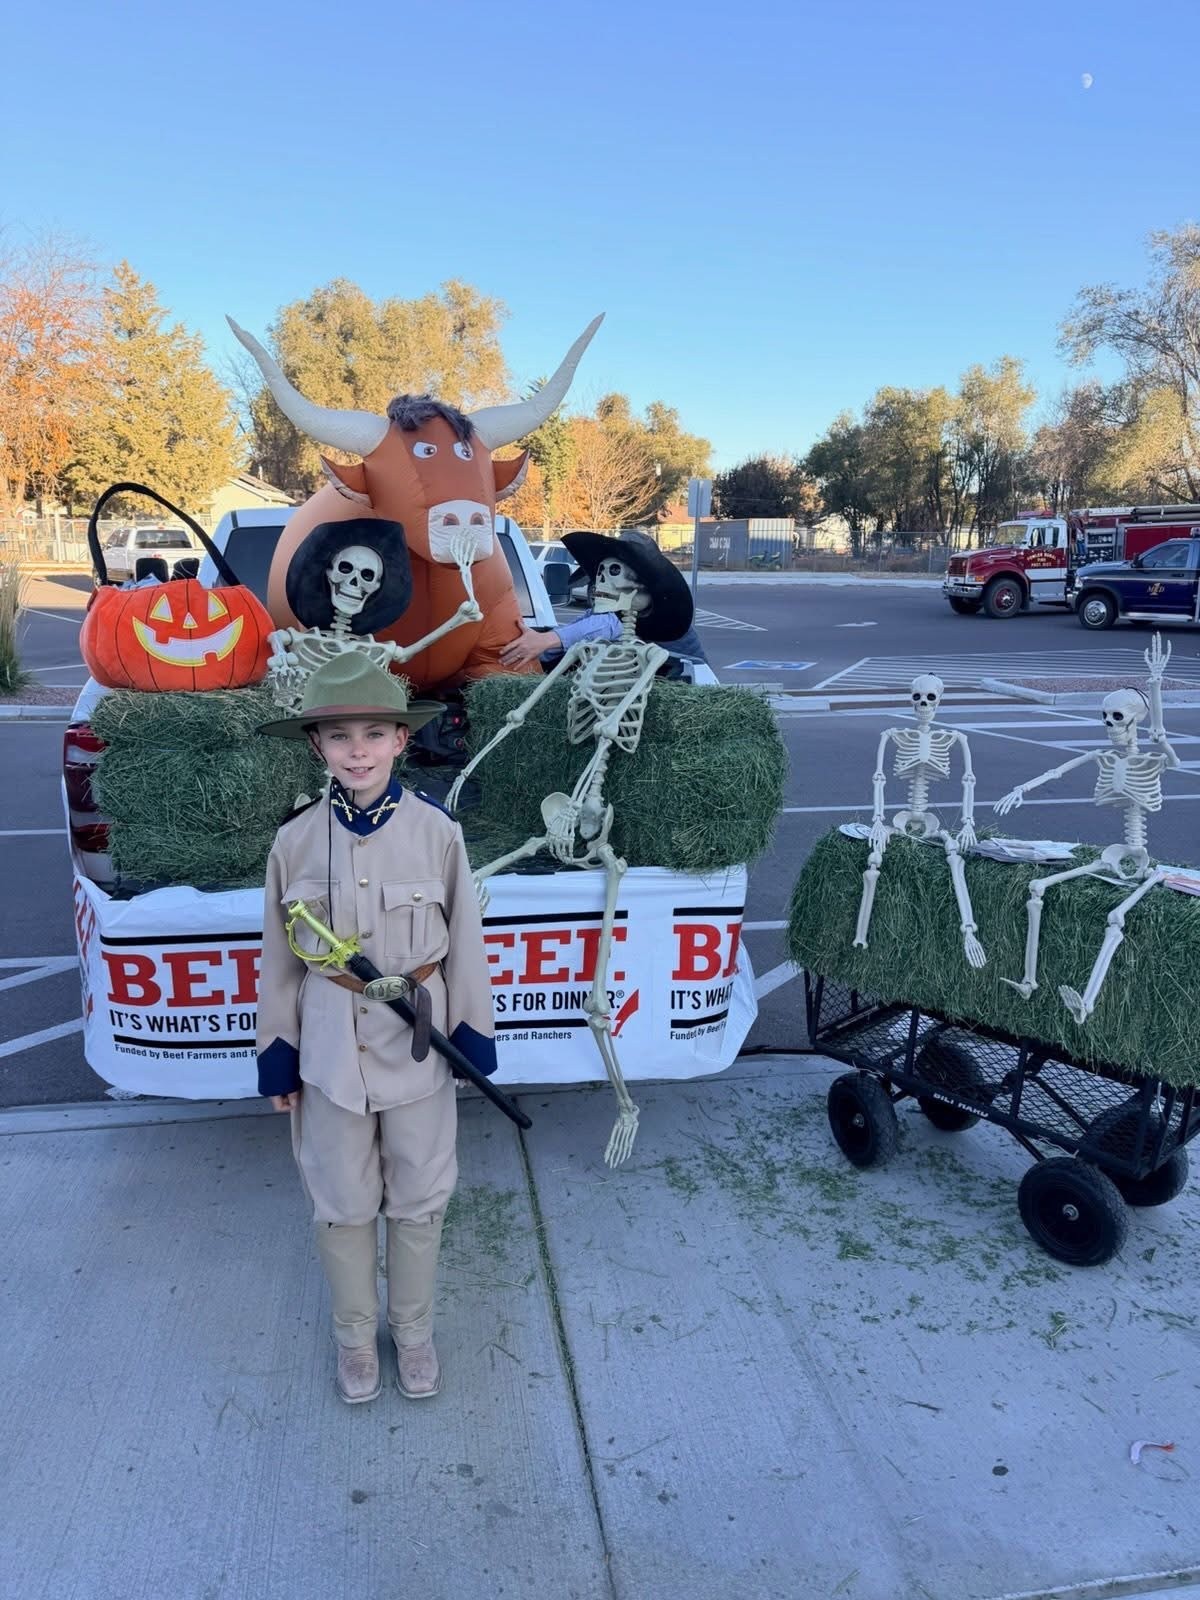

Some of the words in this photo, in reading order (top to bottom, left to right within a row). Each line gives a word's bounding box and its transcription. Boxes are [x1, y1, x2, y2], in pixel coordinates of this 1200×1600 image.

[512, 992, 546, 1012] FOR
[671, 990, 702, 1010] IT'S
[705, 981, 734, 1008] WHAT
[109, 1009, 143, 1031] IT'S
[145, 1013, 221, 1033] WHAT'S
[226, 1012, 257, 1032] FO
[512, 1031, 529, 1041] and
[531, 1030, 573, 1040] Ranchers
[114, 1043, 147, 1057] Funded
[149, 1049, 160, 1060] by
[163, 1050, 185, 1060] Beef
[187, 1050, 228, 1060] Farmers
[230, 1049, 248, 1059] and
